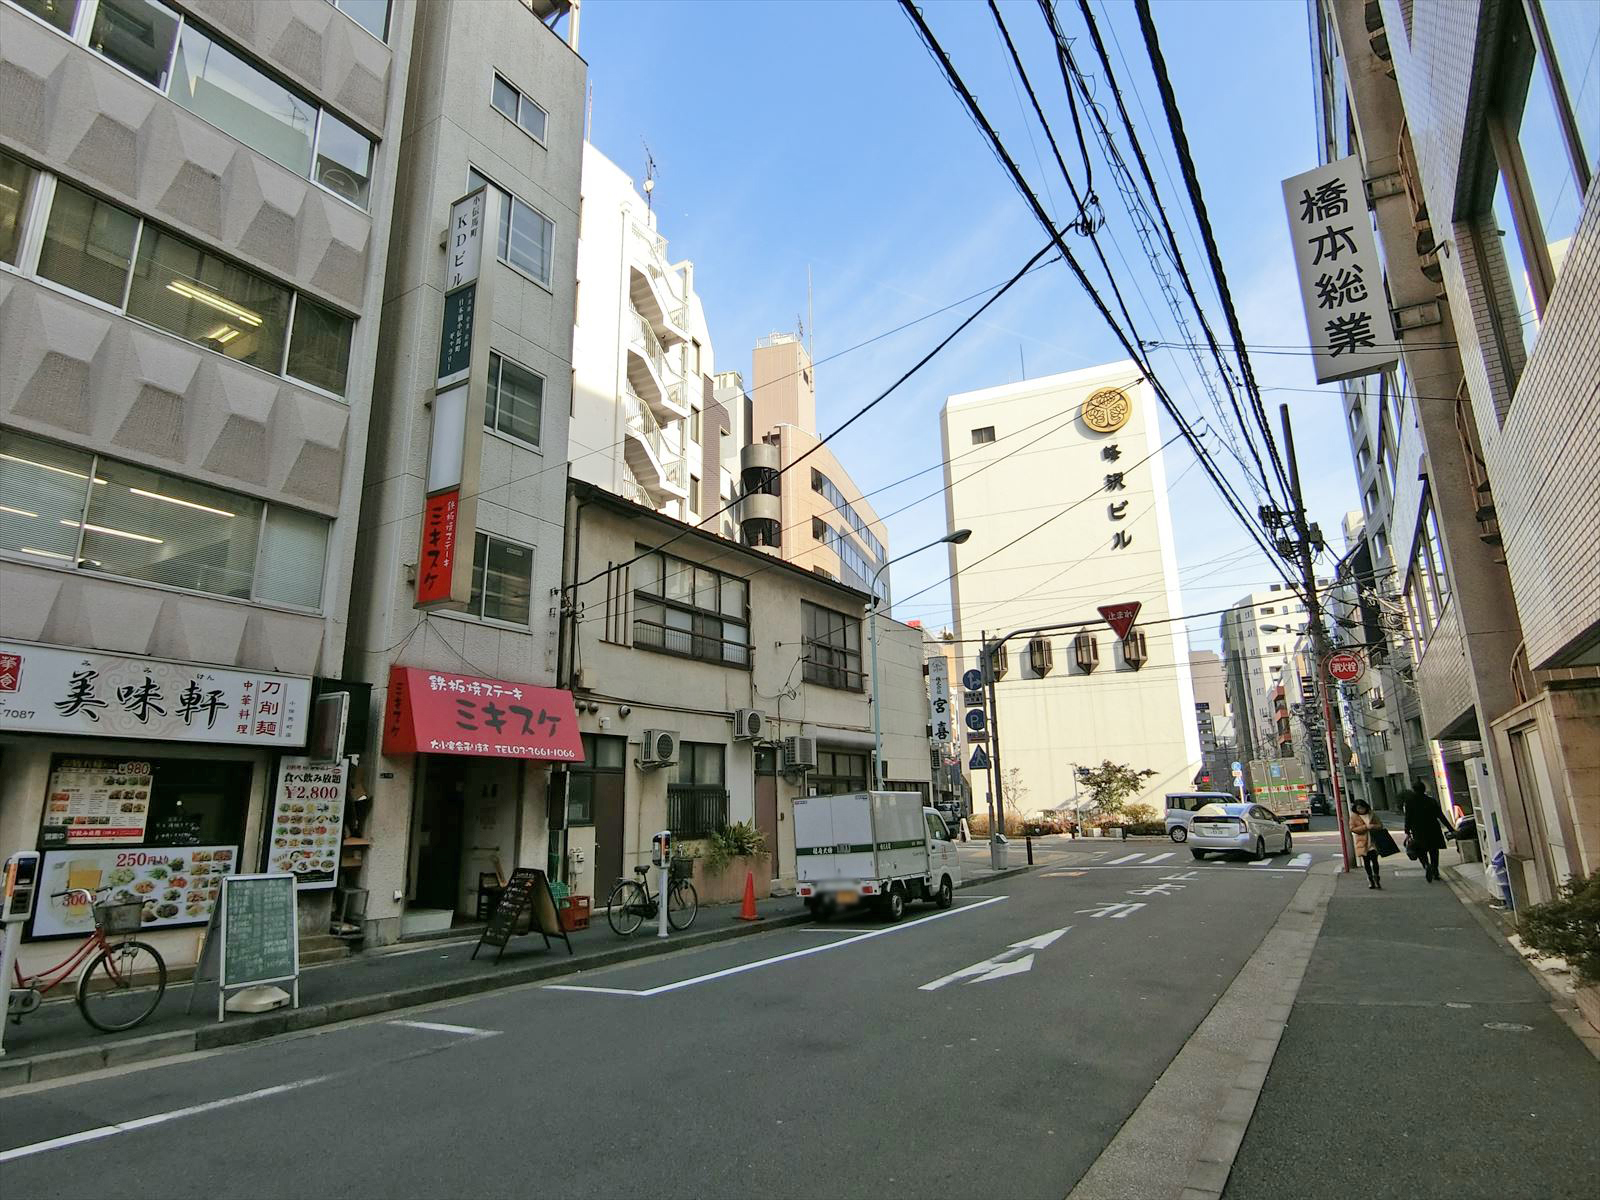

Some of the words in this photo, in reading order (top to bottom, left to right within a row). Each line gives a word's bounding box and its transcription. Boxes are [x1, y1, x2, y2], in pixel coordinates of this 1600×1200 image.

[470, 195, 480, 237] 小伝馬町
[452, 214, 467, 288] KDビル
[1299, 177, 1376, 358] 橋本総業
[424, 506, 442, 591] ミキスケ
[1107, 609, 1134, 621] 止まれ
[428, 674, 524, 701] 鉄板焼ステーキ
[1331, 661, 1357, 673] 消火栓
[54, 670, 230, 729] 美味軒
[236, 680, 253, 734] 中華料理
[455, 699, 562, 738] ミキスケ
[933, 698, 950, 740] 宮喜
[284, 772, 342, 784] 食べ飲み放題
[116, 852, 169, 868] 250円より
[1074, 871, 1199, 918] 止まれ
